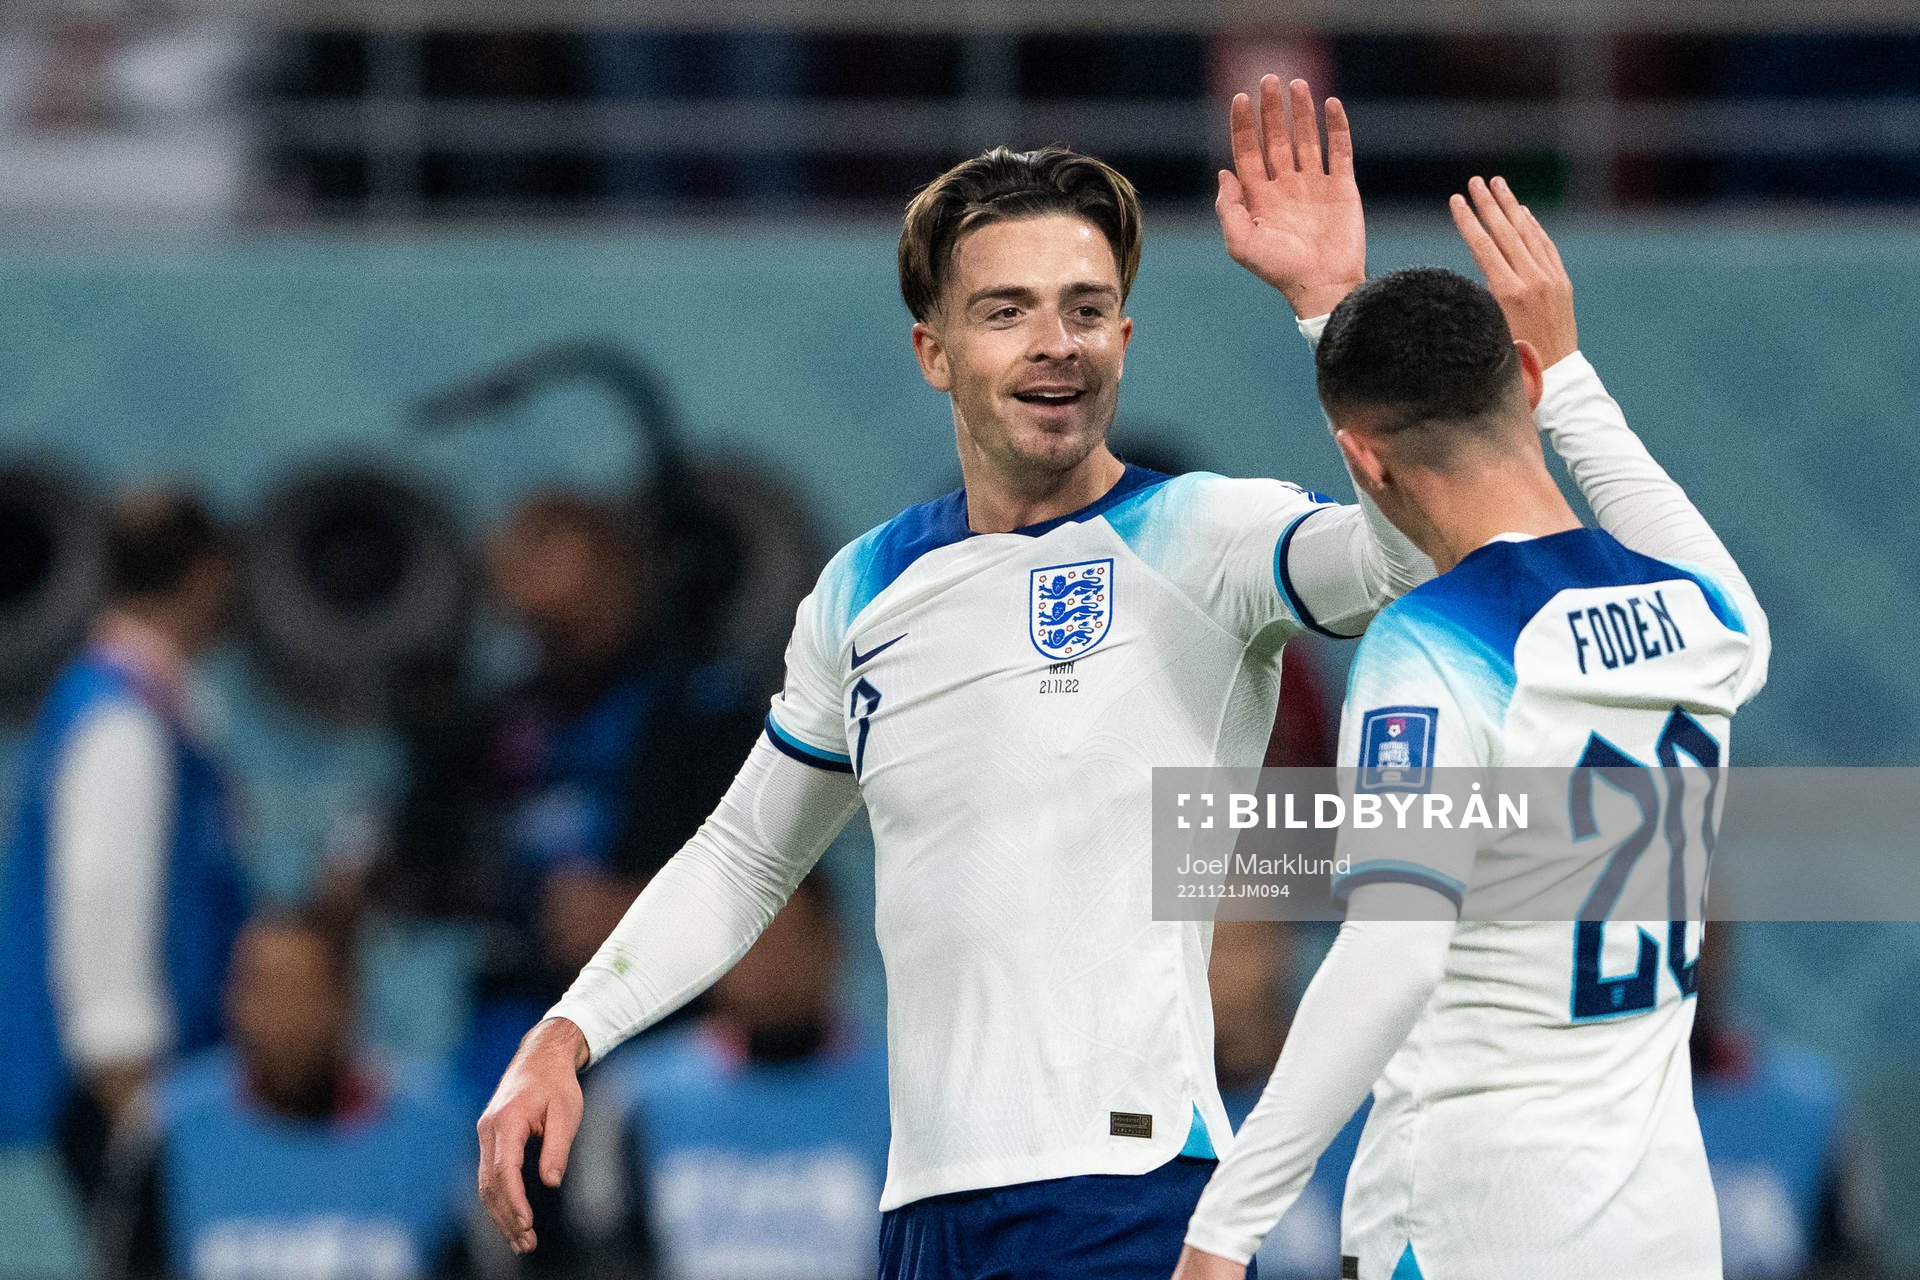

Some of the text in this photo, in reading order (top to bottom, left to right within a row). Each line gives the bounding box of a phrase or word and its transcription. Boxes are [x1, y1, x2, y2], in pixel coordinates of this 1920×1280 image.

[1566, 590, 1687, 675] FODEN
[850, 676, 882, 784] 7
[1039, 679, 1080, 694] 21.11.22
[1569, 704, 1721, 1023] 20
